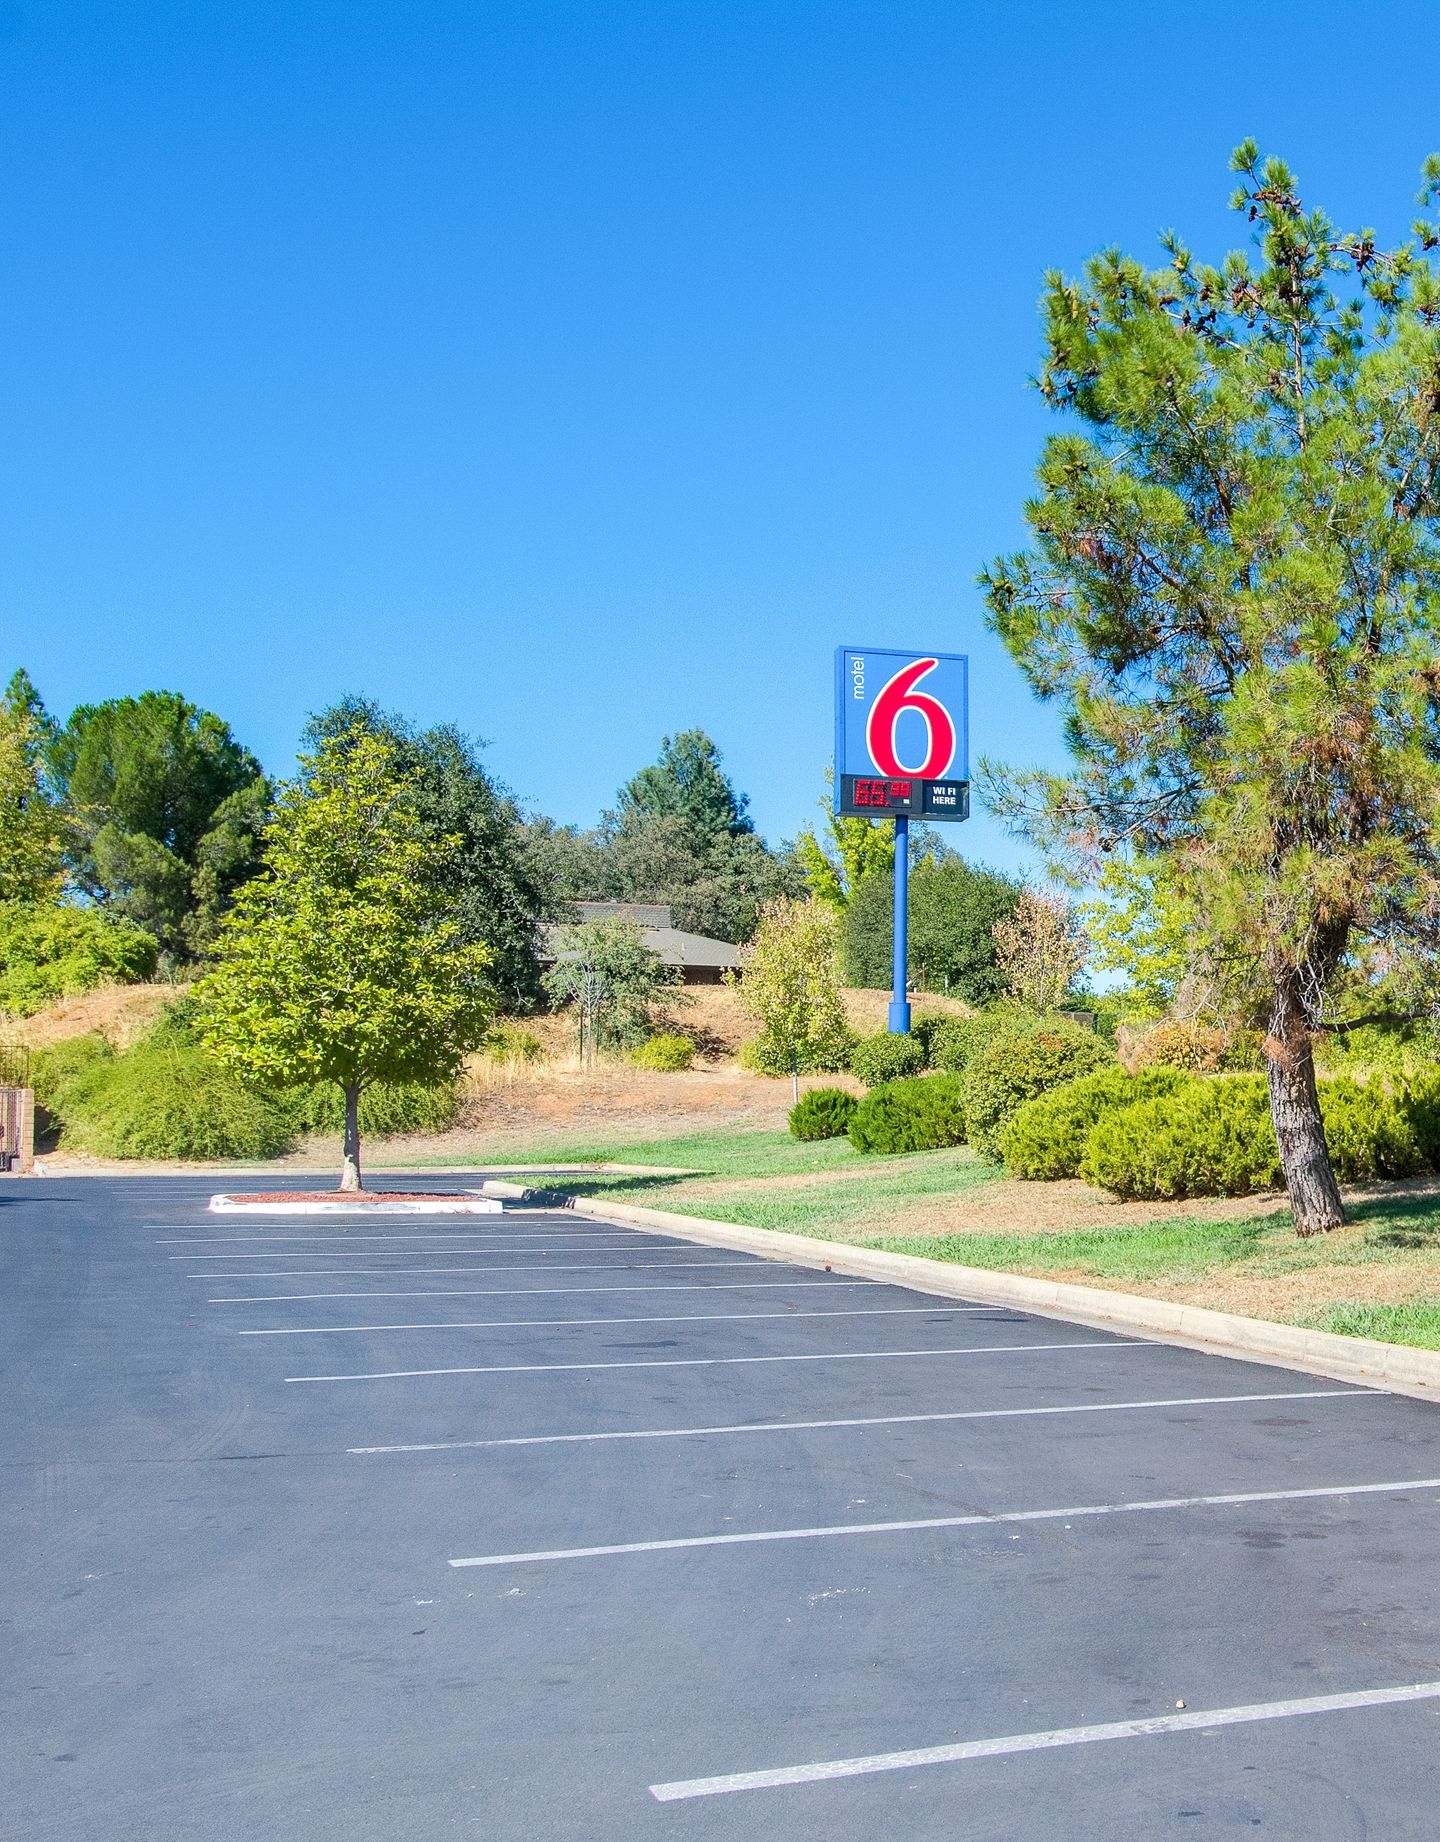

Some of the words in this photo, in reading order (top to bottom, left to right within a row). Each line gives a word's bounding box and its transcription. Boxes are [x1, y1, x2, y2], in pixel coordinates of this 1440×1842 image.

[851, 656, 864, 699] motel
[866, 657, 956, 780] 6
[933, 786, 946, 795] WI
[947, 787, 956, 796] FI
[932, 795, 956, 805] HERE
